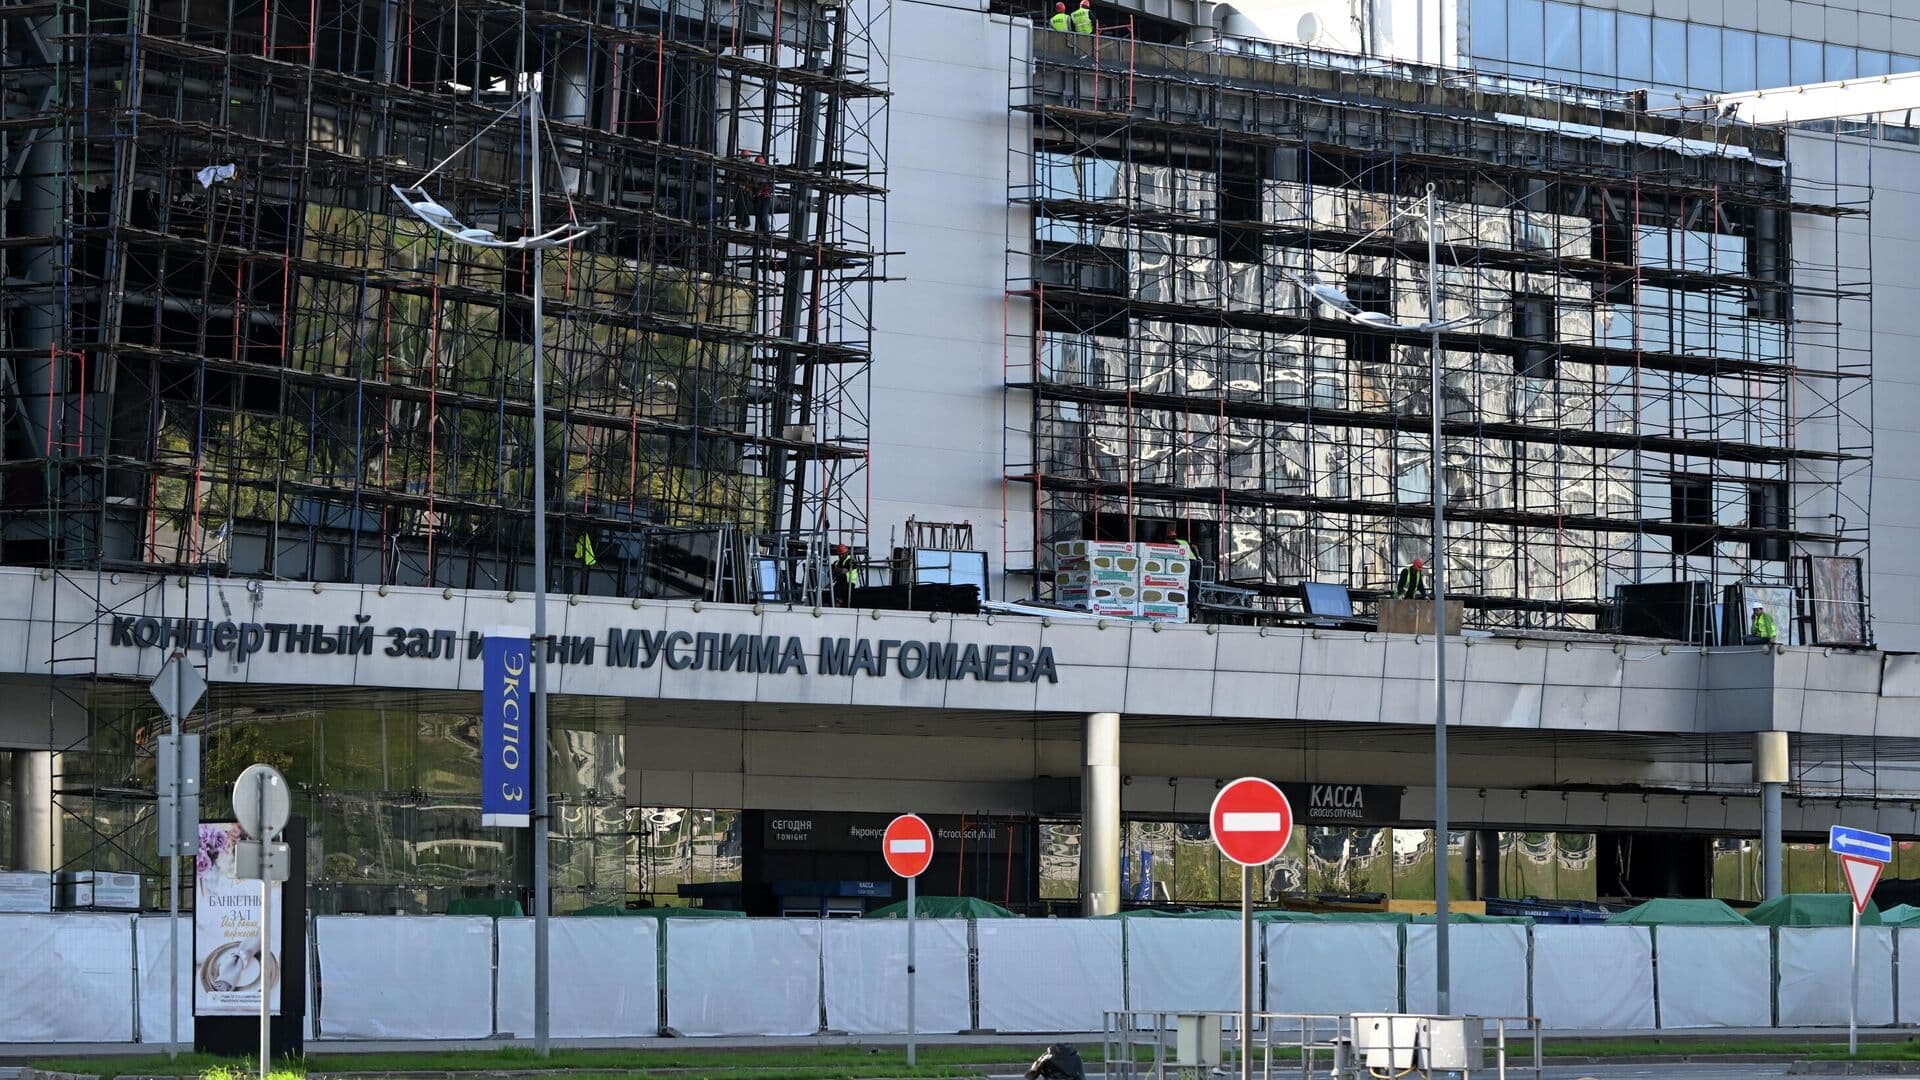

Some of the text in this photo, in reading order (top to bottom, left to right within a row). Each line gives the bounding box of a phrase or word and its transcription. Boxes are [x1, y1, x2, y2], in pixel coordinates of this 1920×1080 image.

[110, 614, 1058, 684] концертный зал ини МУСЛИМА МАГОМАЕВА
[502, 782, 523, 802] 3
[1310, 785, 1363, 808] КАССА
[1310, 808, 1363, 818] CROCUS CITY HALL
[772, 820, 812, 831] СЕГОДНЯ
[776, 833, 808, 841] TONIGHT
[209, 895, 262, 907] БАНКЕТНЫ
[230, 909, 251, 921] ЗАЛ
